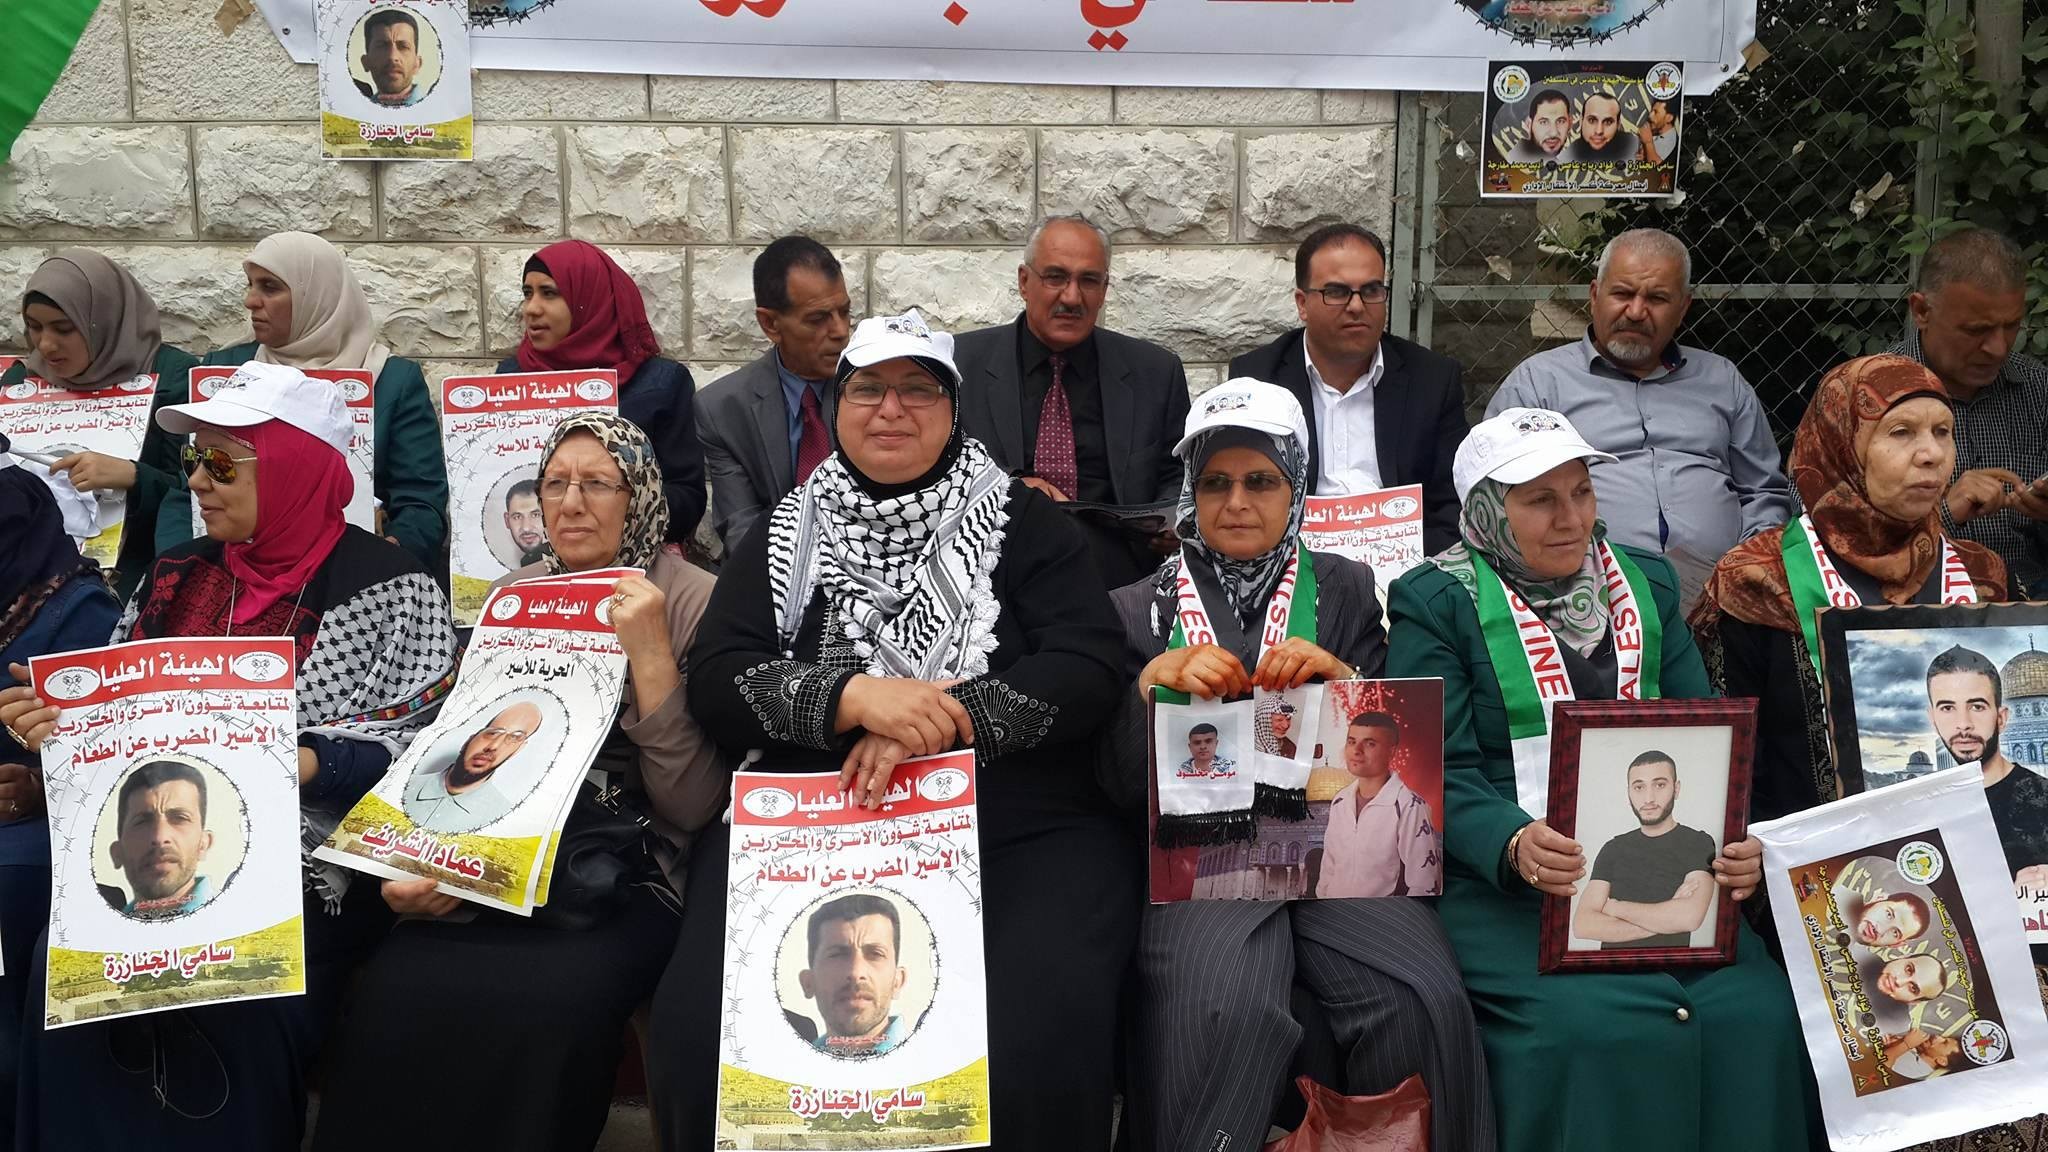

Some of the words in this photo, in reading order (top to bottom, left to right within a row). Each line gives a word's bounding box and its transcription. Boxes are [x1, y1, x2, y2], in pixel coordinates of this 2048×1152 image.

[361, 124, 403, 140] الجنازرة
[405, 125, 434, 143] سامي
[486, 385, 527, 408] العليا
[529, 381, 578, 405] الهيئة
[45, 422, 61, 435] عن
[1302, 507, 1332, 527] العلي
[1335, 502, 1383, 525] الهيئة
[1384, 525, 1420, 541] لمتابعة
[528, 599, 555, 618] العليا
[555, 597, 588, 620] الهيئة
[100, 656, 155, 693] العليا
[159, 651, 234, 683] الهيئة
[539, 659, 575, 682] الحرية
[185, 695, 232, 716] شؤون
[236, 694, 290, 716] لمتابعة
[125, 735, 149, 758] عن
[153, 726, 217, 753] المضرب
[72, 738, 121, 770] الطعام
[797, 788, 853, 819] العليا
[881, 819, 921, 846] شؤون
[924, 813, 971, 838] لمتابعة
[361, 822, 434, 863] الشريف
[741, 833, 822, 853] والمحررين
[433, 843, 484, 879] عماد
[852, 856, 908, 886] المضرب
[756, 864, 816, 886] الطعام
[820, 865, 847, 888] عن
[105, 947, 178, 980] الجنازرة
[183, 943, 233, 975] سامي
[792, 1088, 869, 1115] الجنازرة
[874, 1088, 924, 1120] سامي
